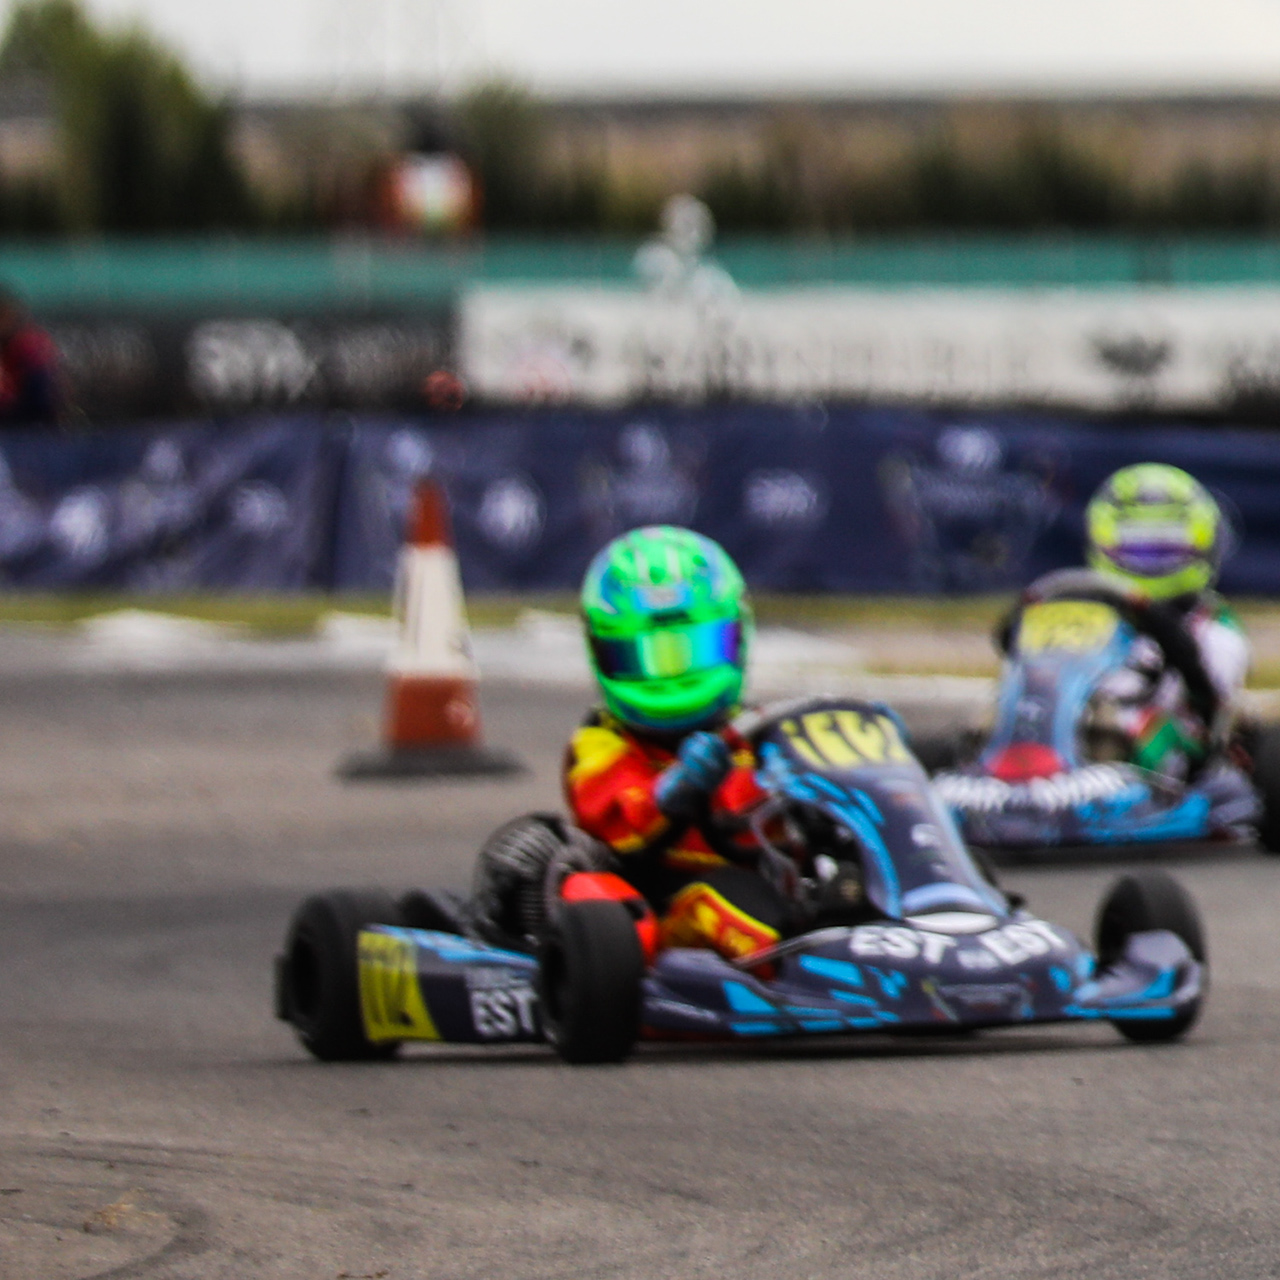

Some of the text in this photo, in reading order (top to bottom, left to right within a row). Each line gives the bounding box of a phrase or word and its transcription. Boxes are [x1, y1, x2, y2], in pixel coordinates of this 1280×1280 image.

[848, 925, 956, 965] EST
[982, 920, 1067, 966] EST
[471, 987, 540, 1037] EST
